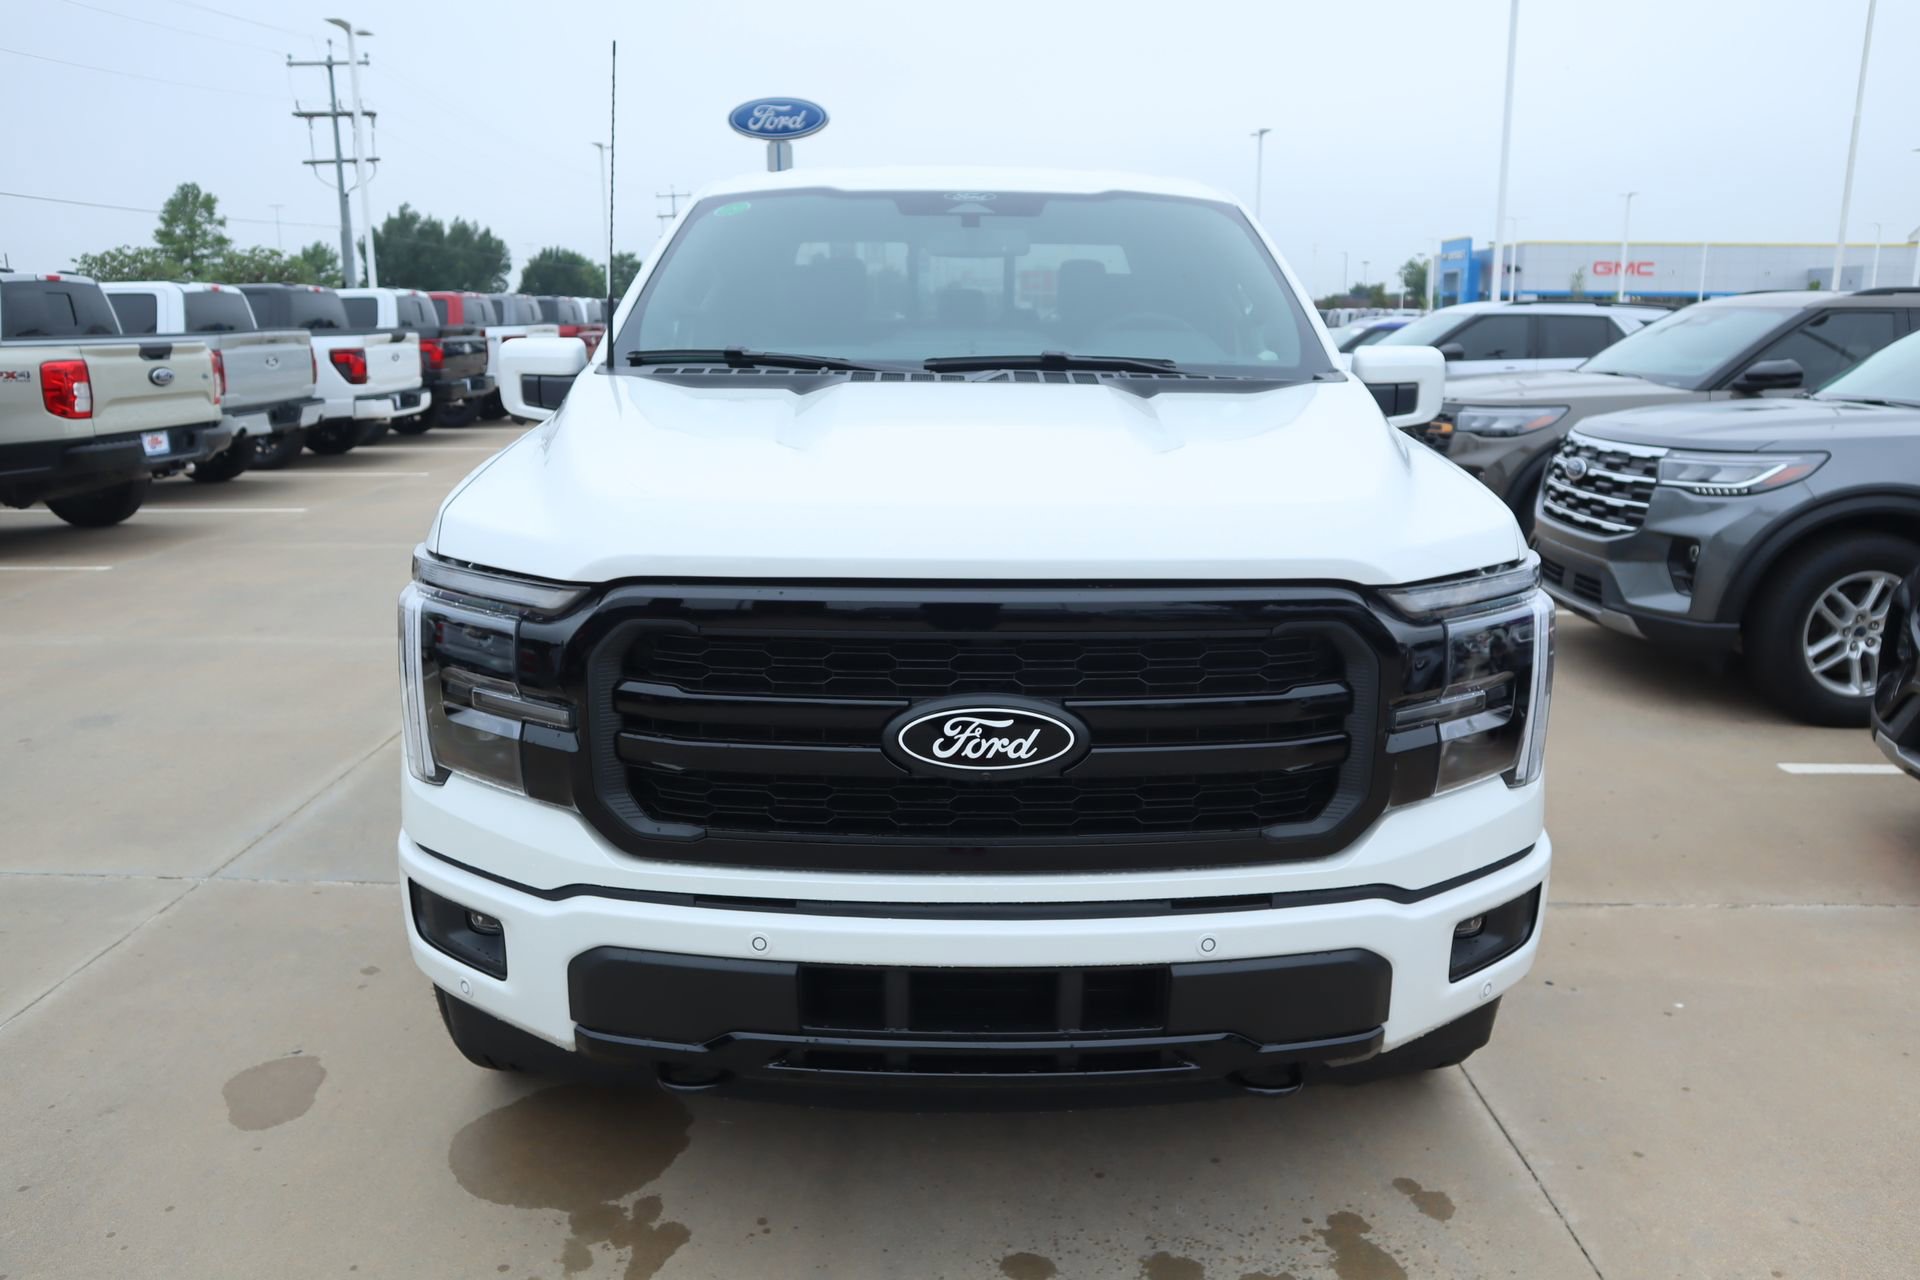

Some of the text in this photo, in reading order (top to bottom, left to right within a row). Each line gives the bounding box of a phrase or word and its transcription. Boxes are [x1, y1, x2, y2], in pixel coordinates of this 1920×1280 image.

[748, 104, 807, 130] Ford
[1592, 260, 1656, 276] GMC
[932, 716, 1041, 760] Ford
